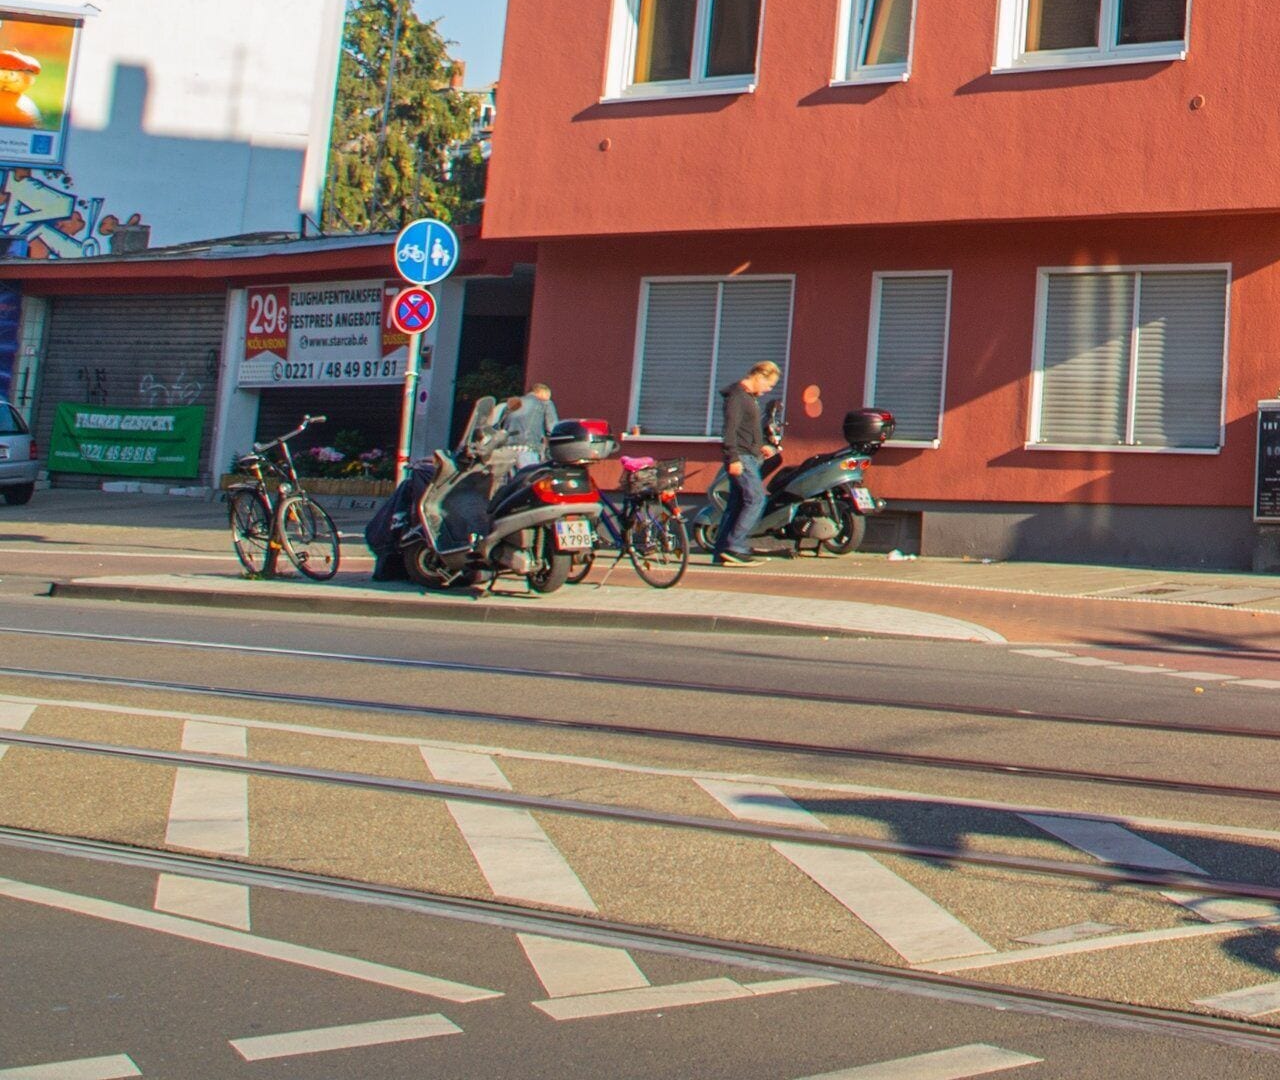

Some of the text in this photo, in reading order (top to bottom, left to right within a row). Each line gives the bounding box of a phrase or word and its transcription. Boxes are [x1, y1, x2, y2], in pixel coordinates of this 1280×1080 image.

[290, 287, 382, 306] FLUGHAFENTRANSFER
[249, 293, 288, 334] 29€
[289, 311, 381, 330] FESTPREIS ANGEBOTE
[309, 334, 368, 347] www.starcab.de
[285, 363, 314, 380] 0221
[326, 362, 341, 379] 48
[343, 361, 361, 378] 49
[364, 360, 379, 377] 81
[382, 360, 397, 376] 81
[75, 412, 175, 431] FAHRER GESUCHT
[567, 523, 575, 533] K
[561, 535, 590, 546] X 798
